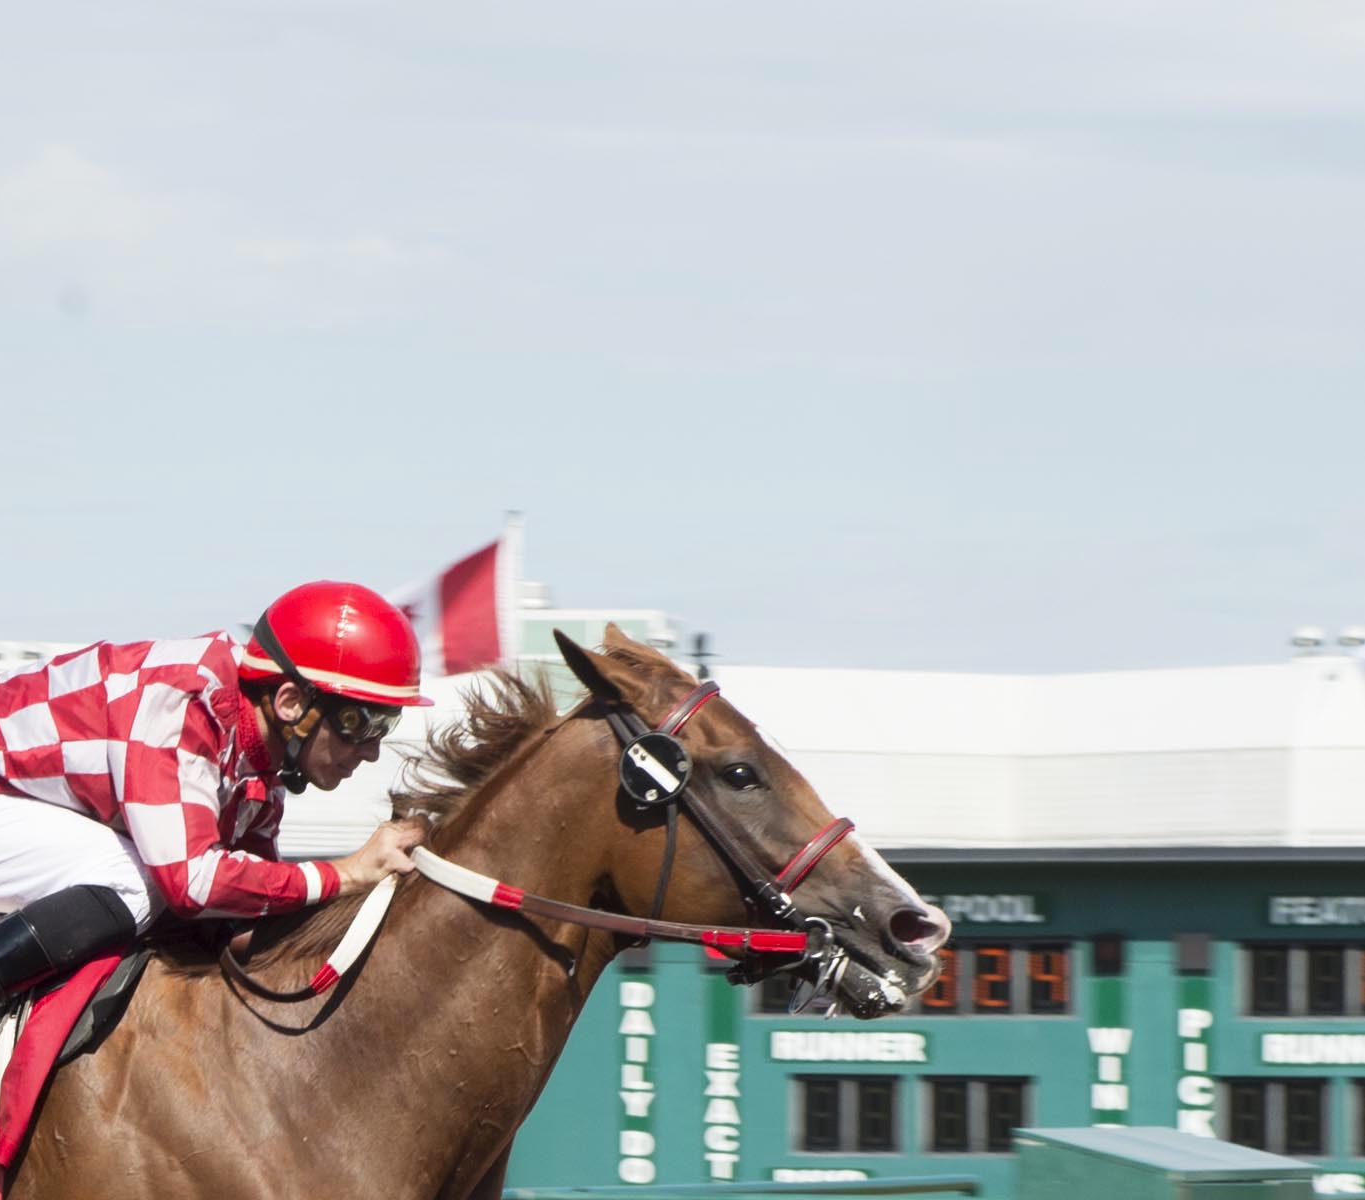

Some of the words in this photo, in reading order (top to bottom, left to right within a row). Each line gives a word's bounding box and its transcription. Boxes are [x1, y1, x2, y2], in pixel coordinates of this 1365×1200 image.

[945, 895, 1046, 922] POOL
[618, 981, 656, 1117] DAILY
[770, 1031, 927, 1061] RUNNER
[1087, 1027, 1133, 1111] WIN
[1177, 1008, 1216, 1139] PICK
